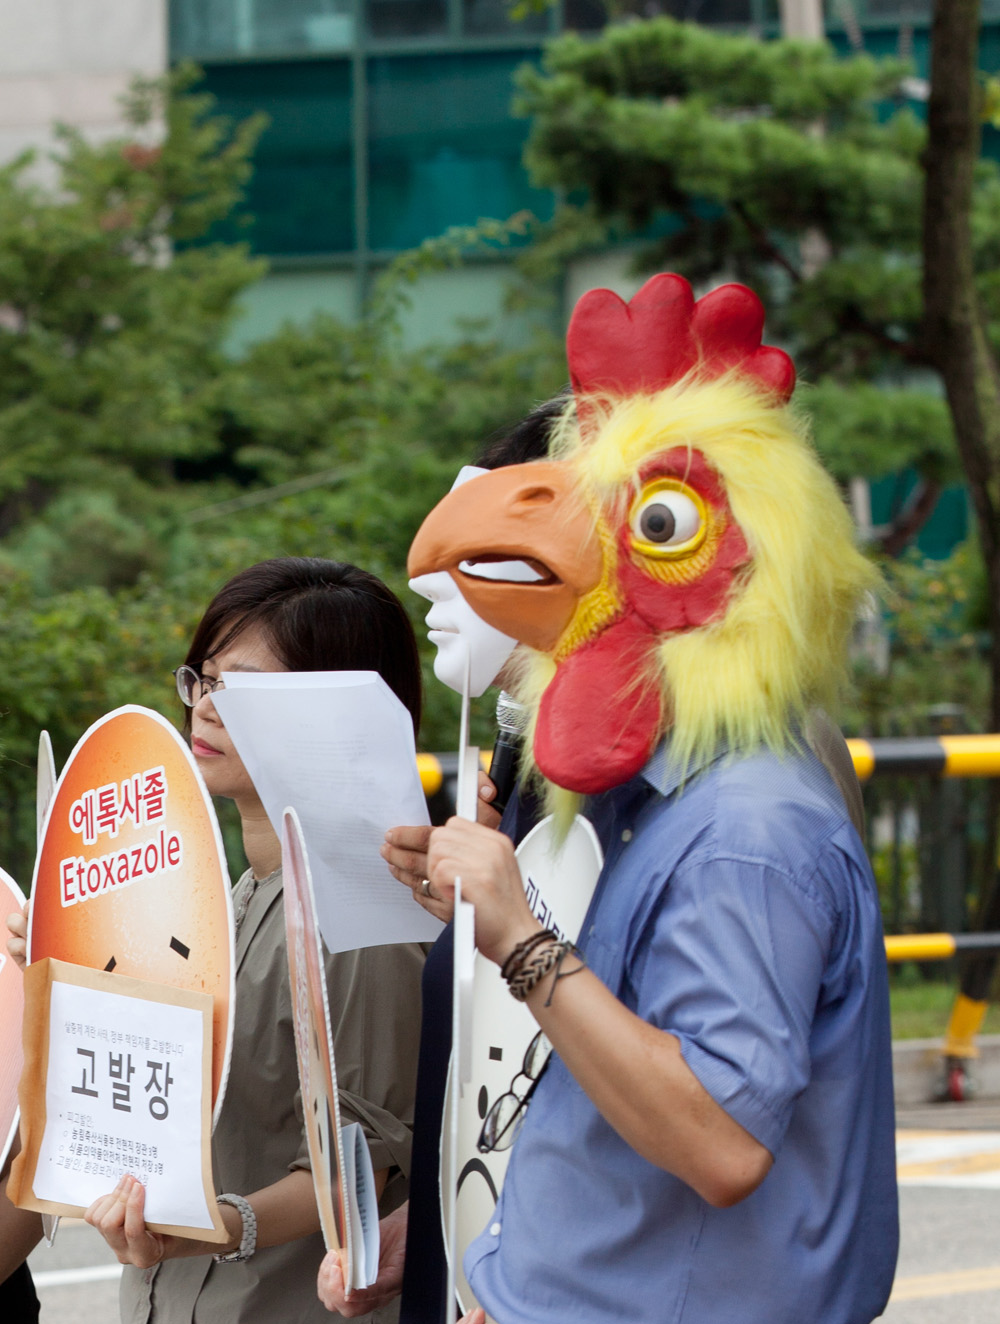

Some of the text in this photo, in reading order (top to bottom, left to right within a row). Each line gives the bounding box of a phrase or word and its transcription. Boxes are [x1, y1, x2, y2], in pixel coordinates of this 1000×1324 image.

[72, 771, 165, 840] 에톡사졸
[63, 830, 180, 902] Etoxazole
[71, 1047, 174, 1121] 고발장
